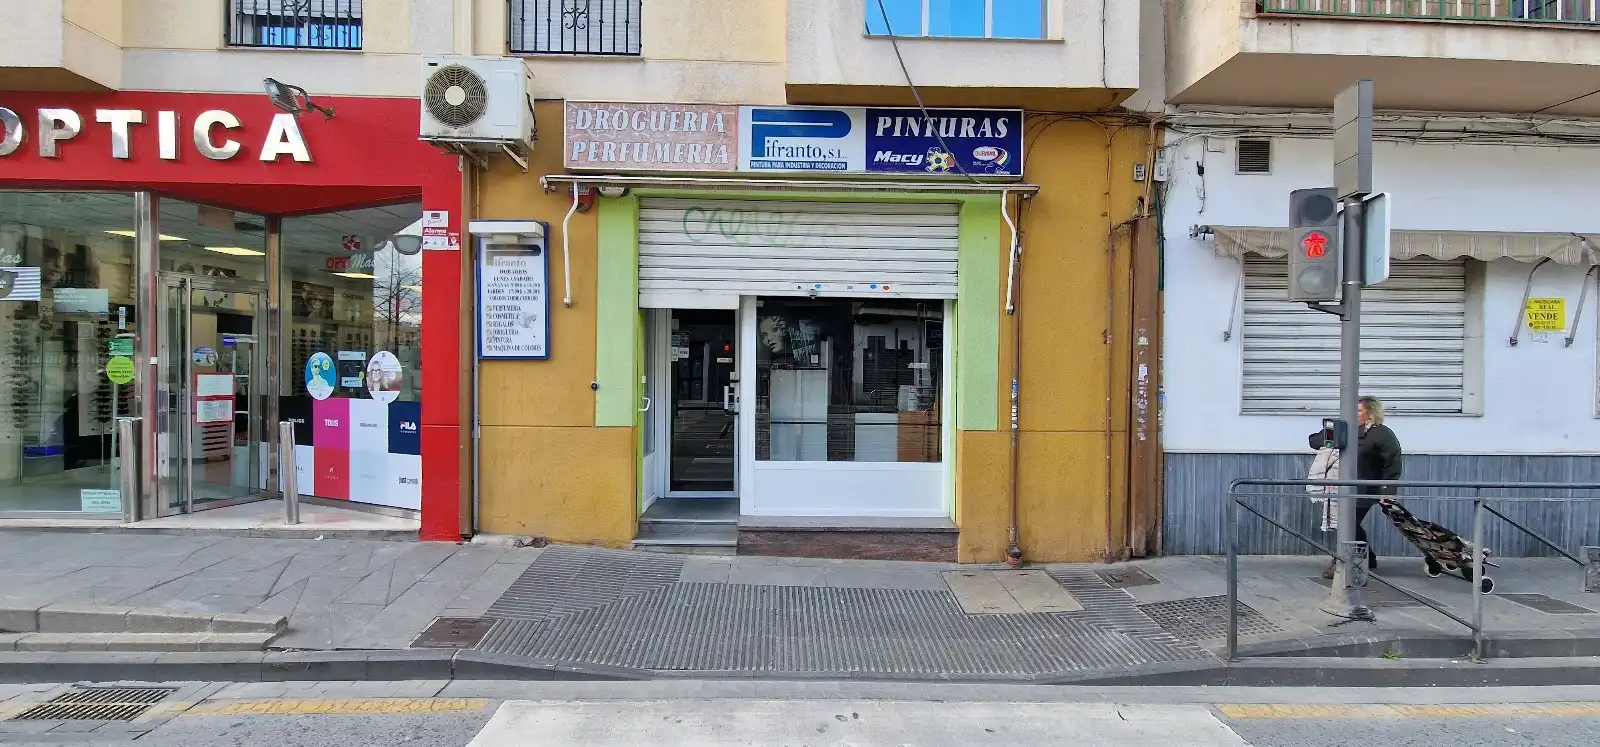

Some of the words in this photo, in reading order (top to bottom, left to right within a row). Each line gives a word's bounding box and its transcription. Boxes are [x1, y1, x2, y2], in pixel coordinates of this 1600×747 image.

[575, 109, 726, 133] DROGUERIA
[874, 116, 1009, 138] PINTURAS
[570, 140, 729, 164] PERFUMERIA
[873, 150, 924, 166] Macy
[750, 161, 771, 169] PINTURA
[771, 161, 785, 169] PARA
[785, 161, 811, 169] INDUSTRIA
[815, 162, 846, 170] DECORACION
[492, 304, 522, 312] PERFUMERIA
[1527, 312, 1559, 321] VENDE
[324, 418, 339, 427] TOUS
[399, 420, 417, 430] FILA
